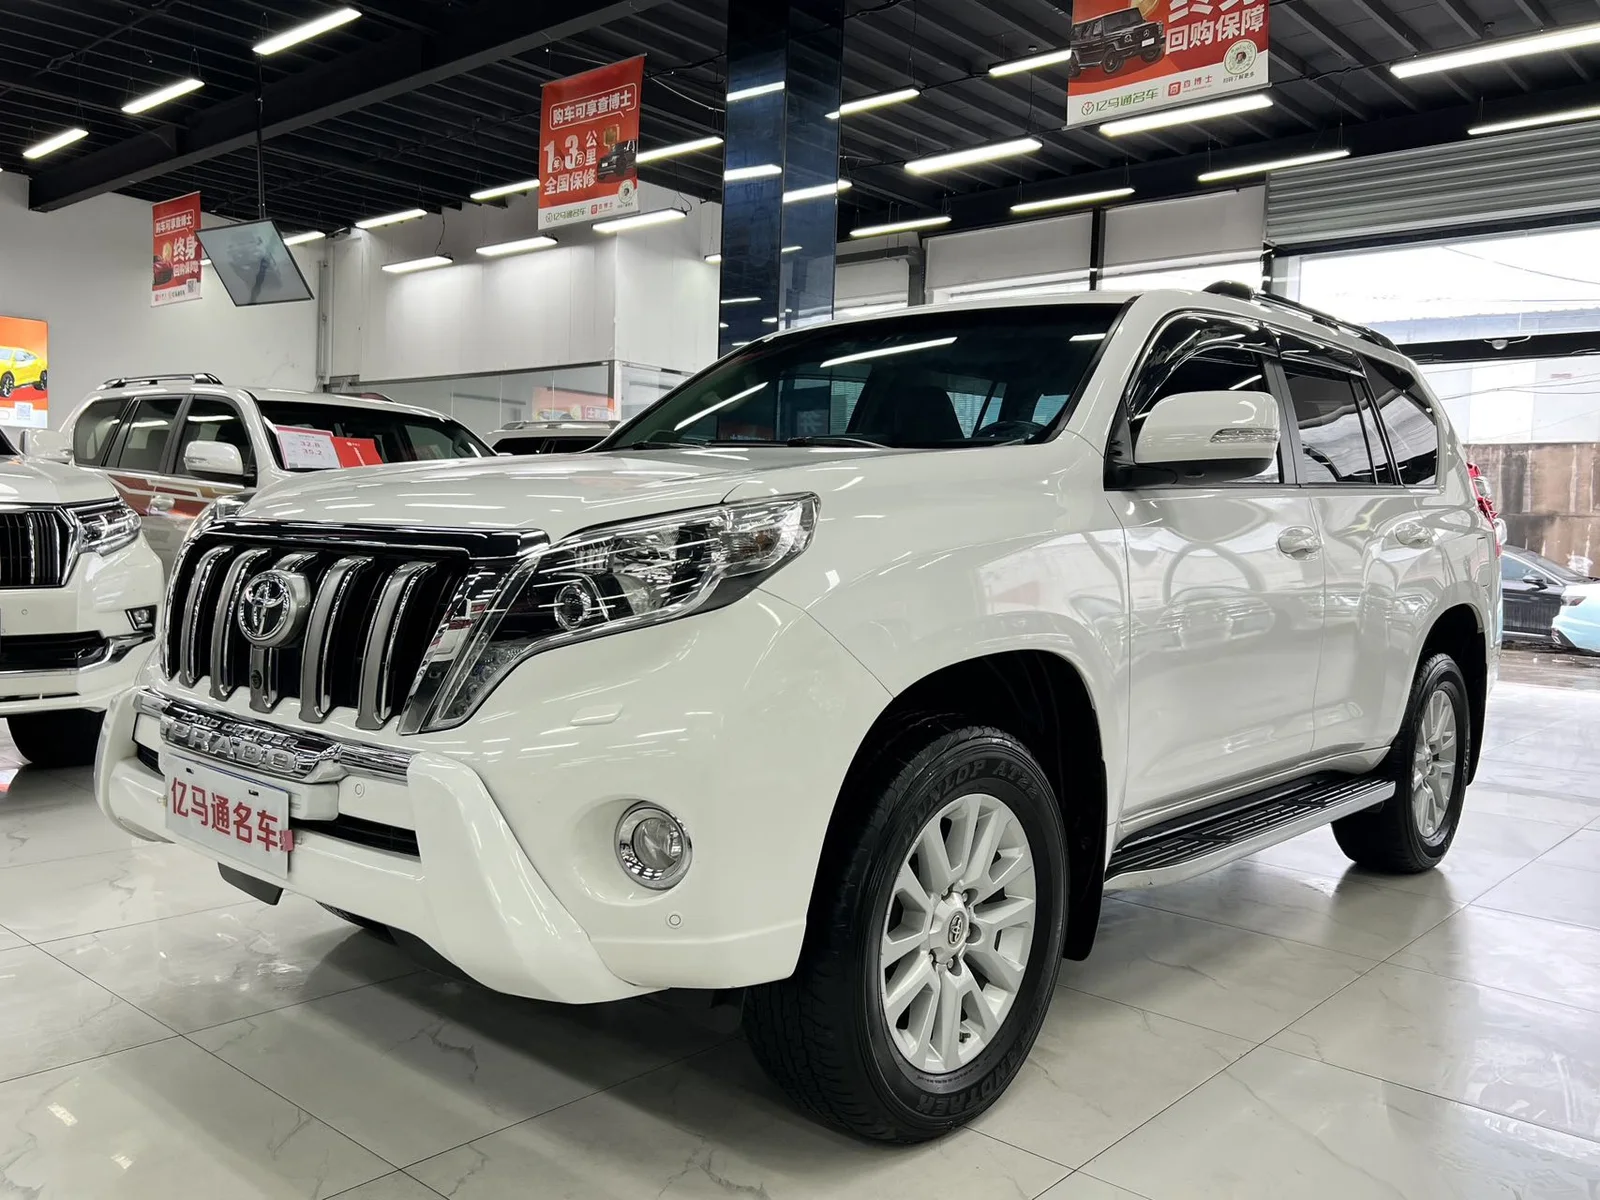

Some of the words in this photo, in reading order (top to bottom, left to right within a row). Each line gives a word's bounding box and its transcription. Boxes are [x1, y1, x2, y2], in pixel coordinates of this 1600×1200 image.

[1165, 3, 1265, 55] 回购保障
[553, 90, 632, 125] 购车可享查博士
[1096, 87, 1158, 112] 亿马通名车
[544, 168, 596, 196] 全国保修
[173, 235, 198, 261] 终身
[166, 721, 296, 773] PRADO
[171, 777, 278, 852] 亿马通名车
